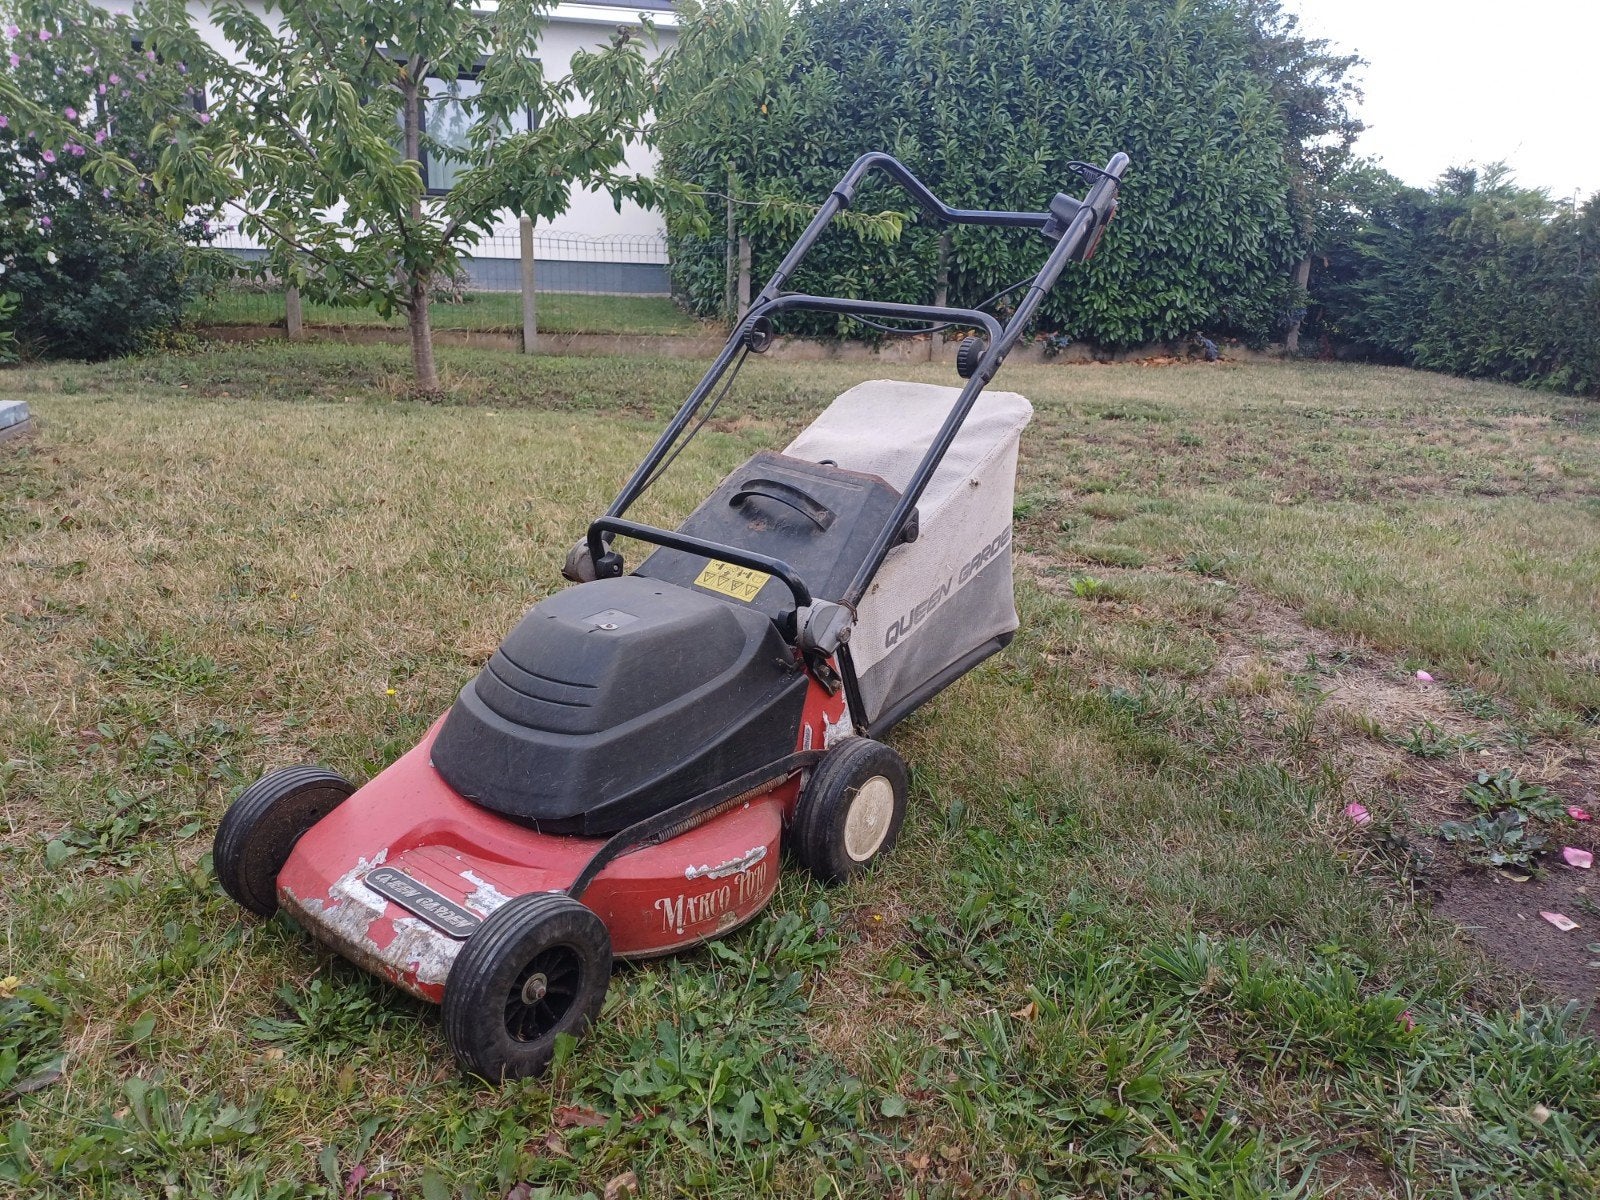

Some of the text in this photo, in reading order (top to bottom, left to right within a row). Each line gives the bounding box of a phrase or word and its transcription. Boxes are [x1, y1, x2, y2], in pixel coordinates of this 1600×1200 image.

[885, 576, 953, 648] QUEEN
[374, 873, 475, 928] QUEEN GARDEN
